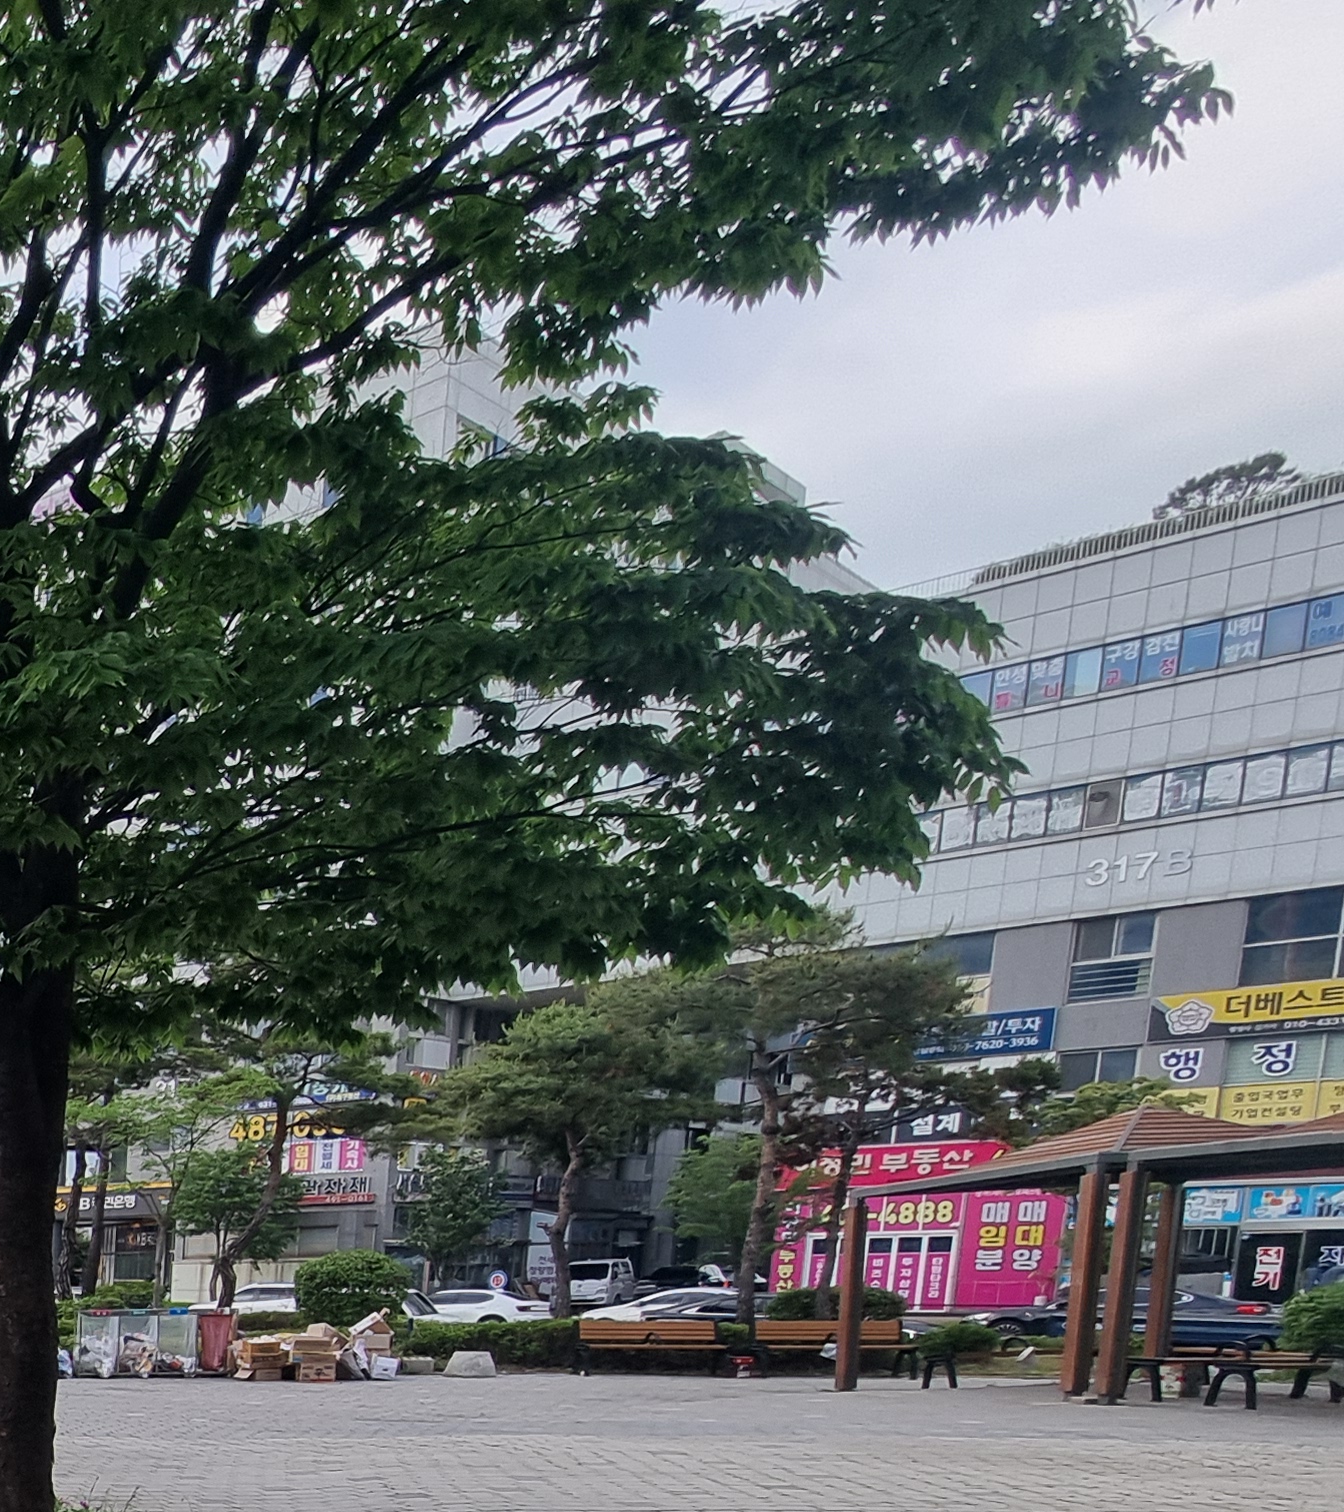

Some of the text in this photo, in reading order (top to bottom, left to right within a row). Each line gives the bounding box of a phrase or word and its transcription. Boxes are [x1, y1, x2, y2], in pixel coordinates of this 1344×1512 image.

[1224, 612, 1265, 637] 사랑니
[1105, 631, 1181, 664] 구강 검진
[1223, 640, 1259, 663] 발치
[994, 665, 1028, 688] 안성
[1224, 985, 1344, 1018] 더베스트
[910, 1112, 962, 1137] 설계
[293, 1142, 310, 1173] 임대
[878, 1148, 976, 1176] 부동산
[980, 1200, 1048, 1224] 매매
[978, 1224, 1046, 1248] 임대
[974, 1248, 1043, 1272] 분양
[1251, 1246, 1285, 1291] 전기
